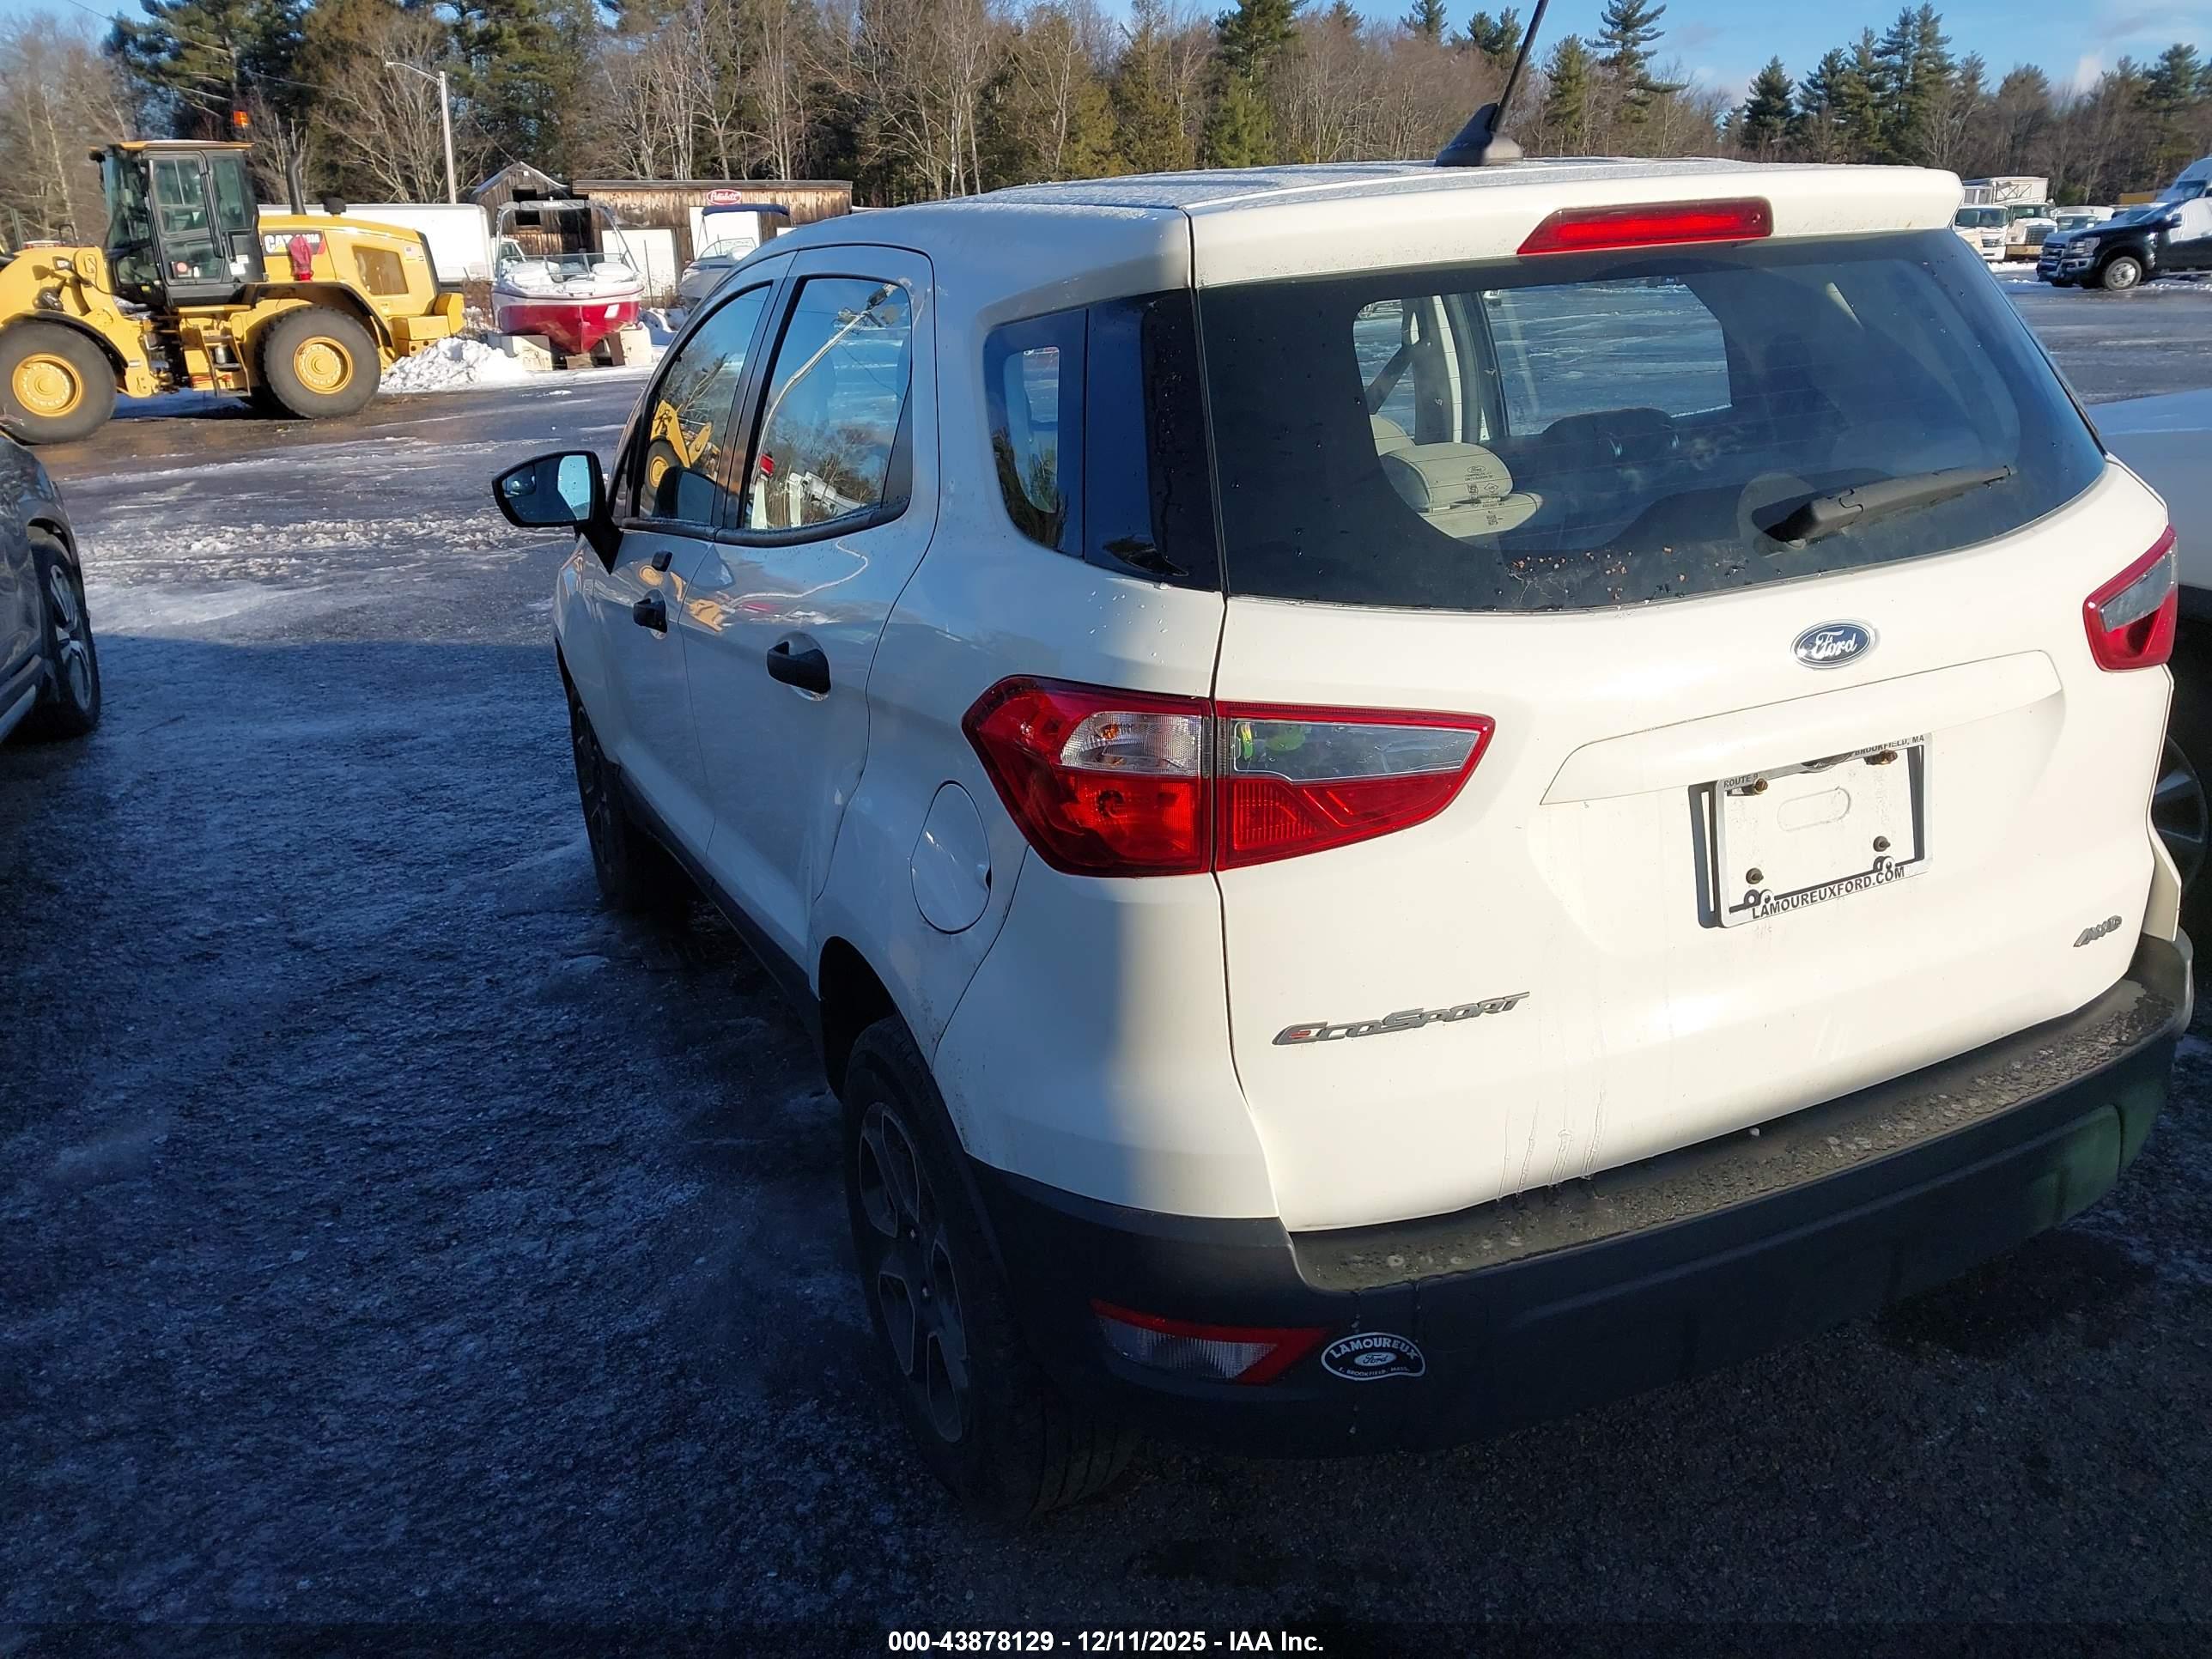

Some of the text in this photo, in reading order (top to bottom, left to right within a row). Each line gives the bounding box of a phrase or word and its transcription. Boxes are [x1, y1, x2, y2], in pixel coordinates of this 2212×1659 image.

[264, 234, 293, 253] CAT
[1809, 629, 1858, 659] Ford
[1911, 734, 1924, 744] MA
[1723, 775, 1752, 788] ROUTE
[1751, 866, 1905, 920] LAMOUREUXFORD.COM
[2073, 915, 2123, 947] AWD
[1329, 1337, 1419, 1359] LAMOUREUX
[1362, 1353, 1389, 1364] Ford
